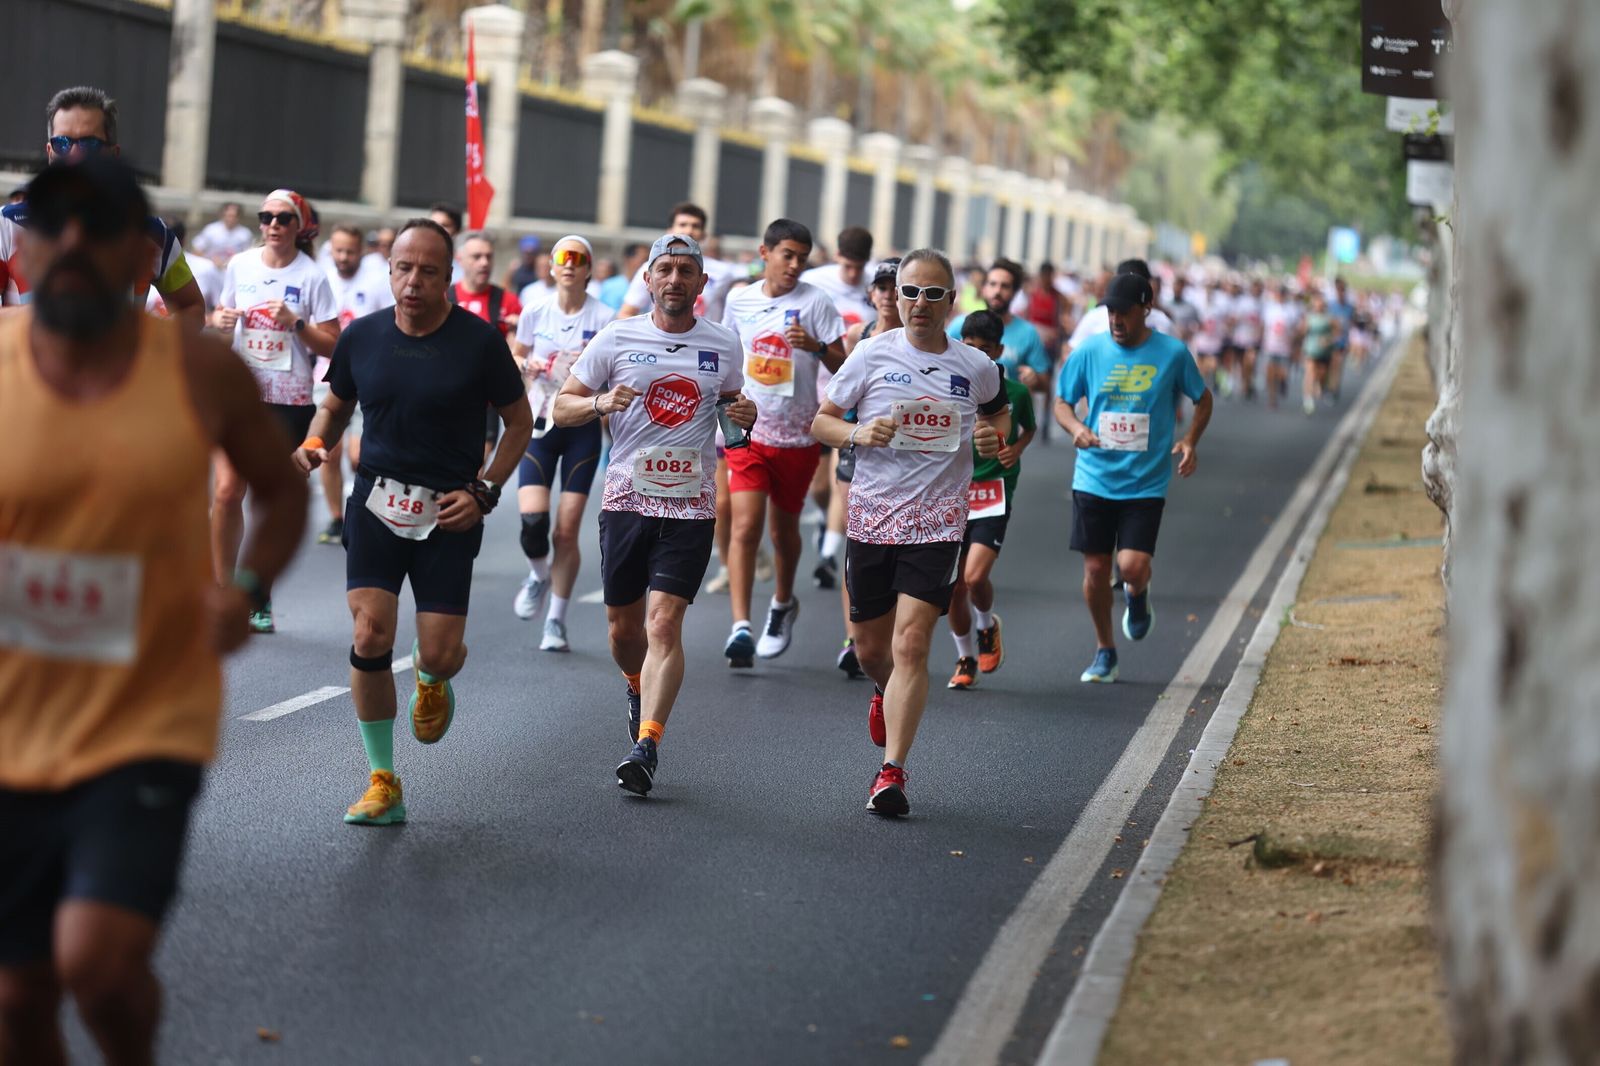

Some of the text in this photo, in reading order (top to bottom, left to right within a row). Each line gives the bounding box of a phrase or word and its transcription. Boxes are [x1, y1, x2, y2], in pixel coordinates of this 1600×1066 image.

[247, 340, 284, 352] 1124
[698, 360, 716, 371] AXA
[655, 386, 696, 407] PONLE
[651, 396, 690, 416] FRENO
[902, 412, 951, 427] 1083
[1110, 422, 1136, 433] 351
[645, 458, 692, 473] 1082
[387, 494, 424, 515] 148
